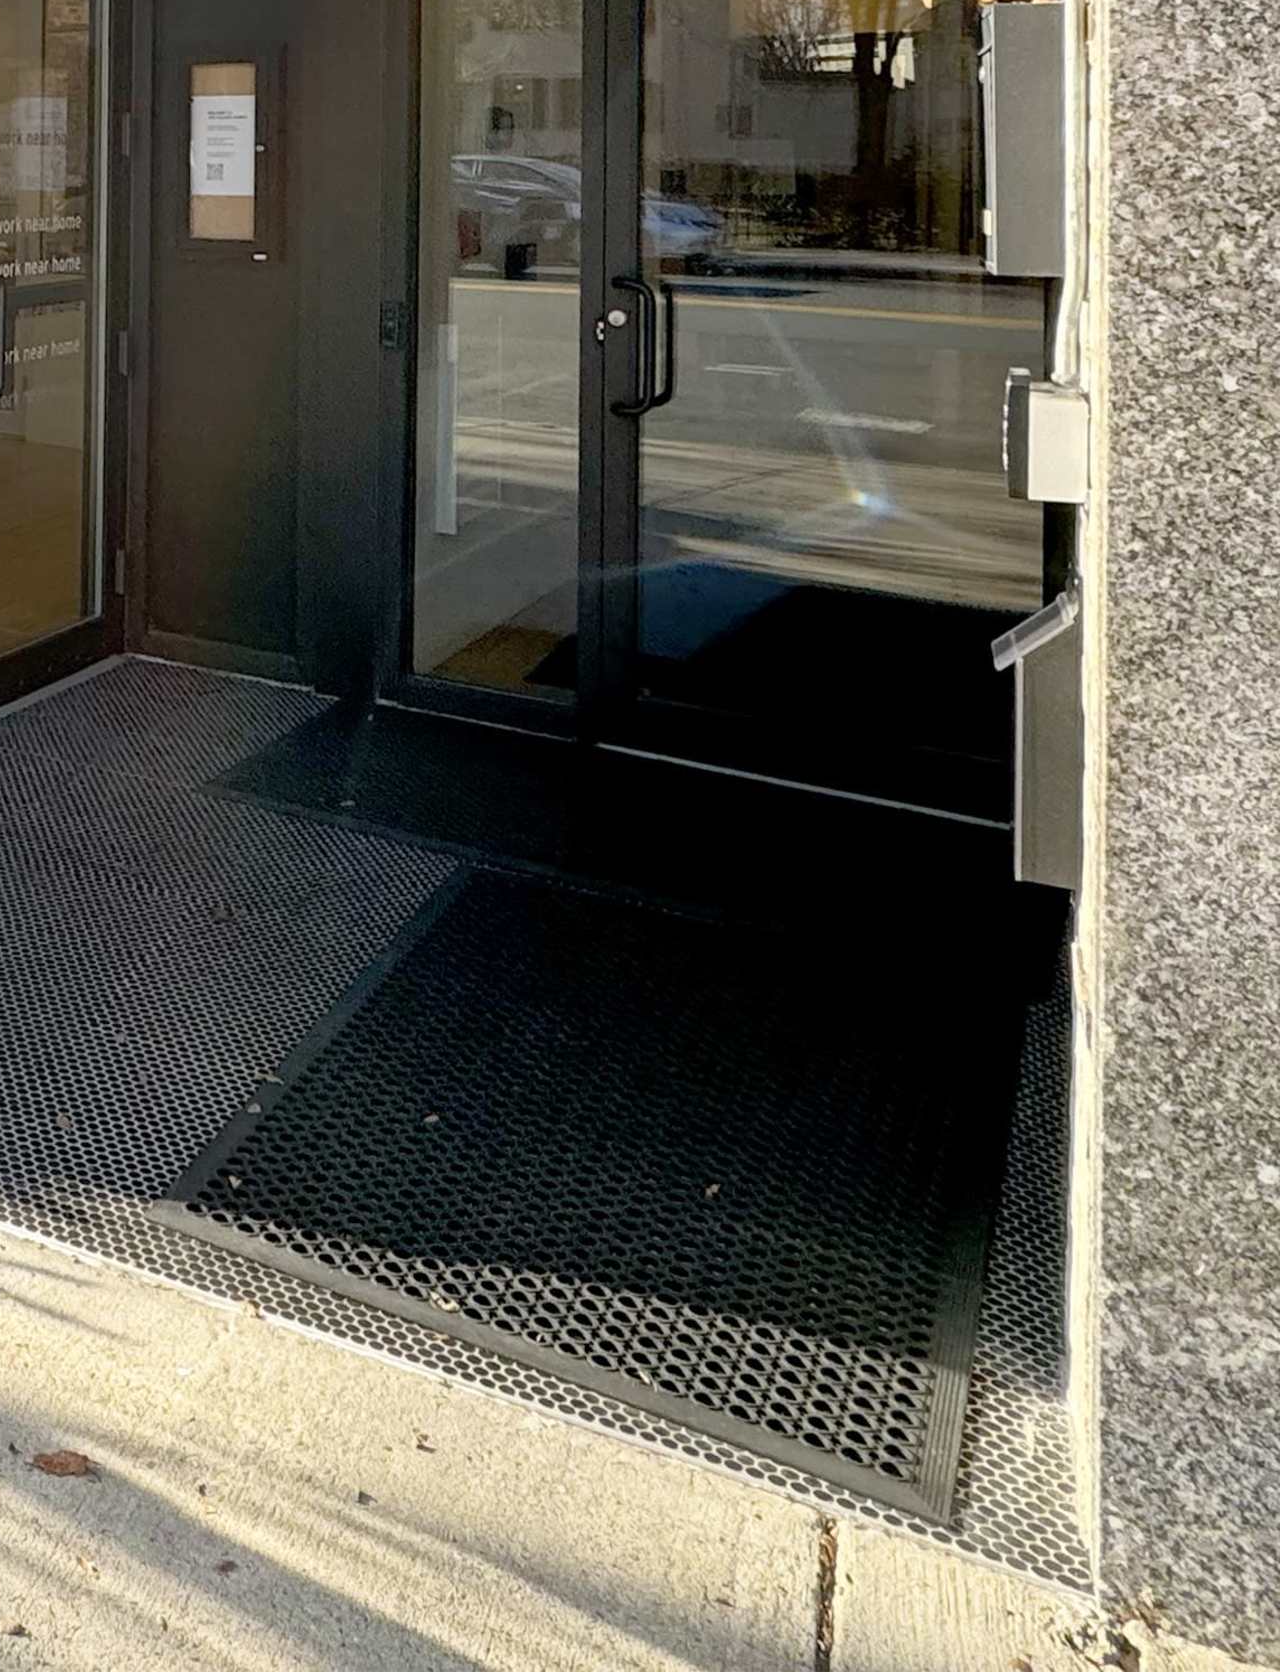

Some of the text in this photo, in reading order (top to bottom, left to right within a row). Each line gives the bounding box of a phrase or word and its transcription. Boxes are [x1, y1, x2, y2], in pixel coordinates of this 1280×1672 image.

[25, 217, 50, 232] near
[24, 258, 49, 275] near
[52, 257, 80, 272] home
[23, 345, 48, 361] near
